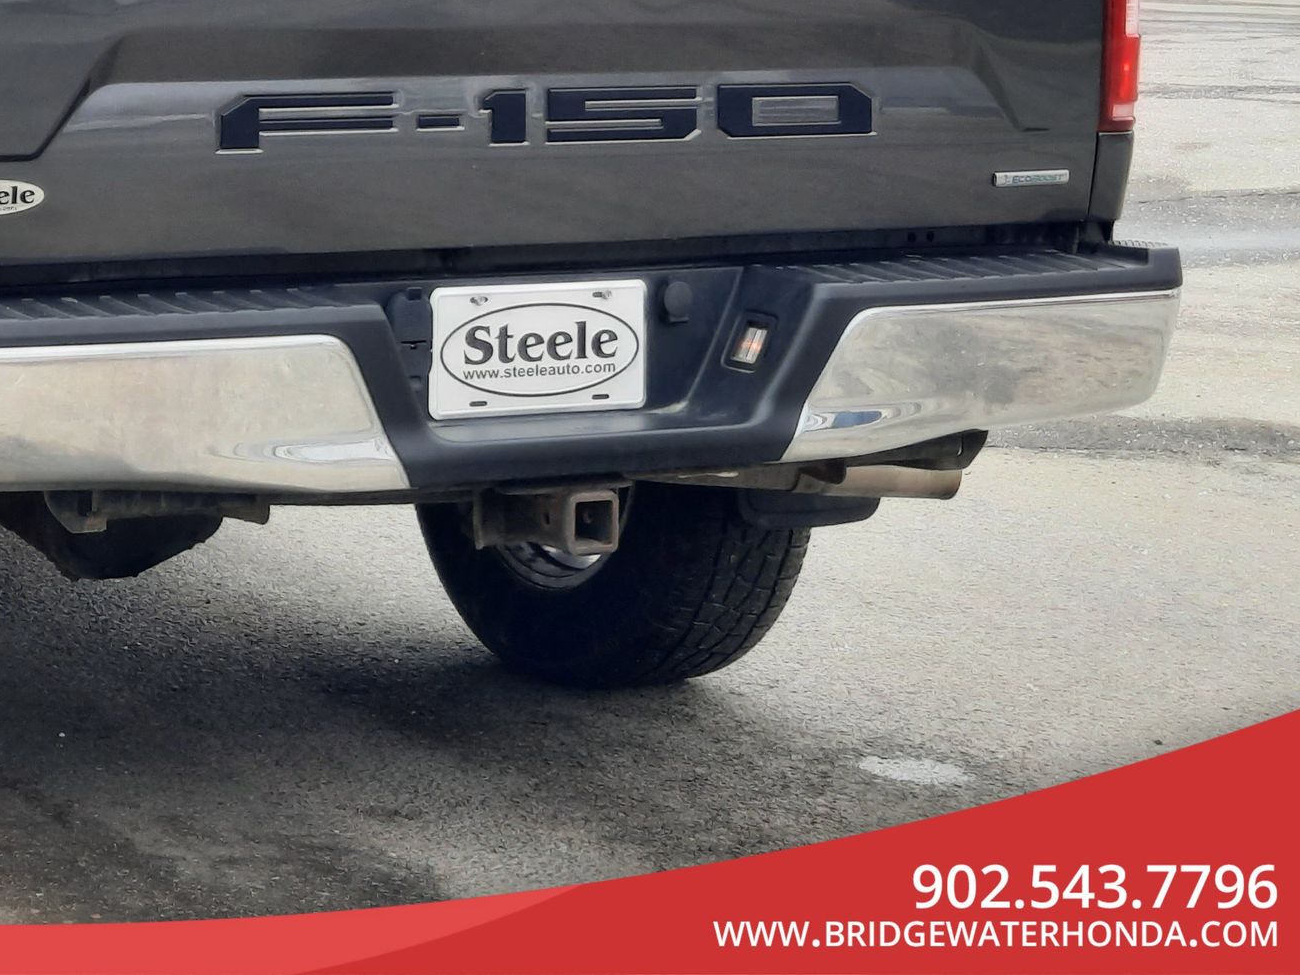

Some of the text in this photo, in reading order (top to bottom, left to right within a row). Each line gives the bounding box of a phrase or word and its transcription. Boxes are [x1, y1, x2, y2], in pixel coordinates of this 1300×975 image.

[216, 81, 876, 153] F-150
[463, 320, 619, 365] Steele
[463, 362, 616, 379] www.steeleauto.com
